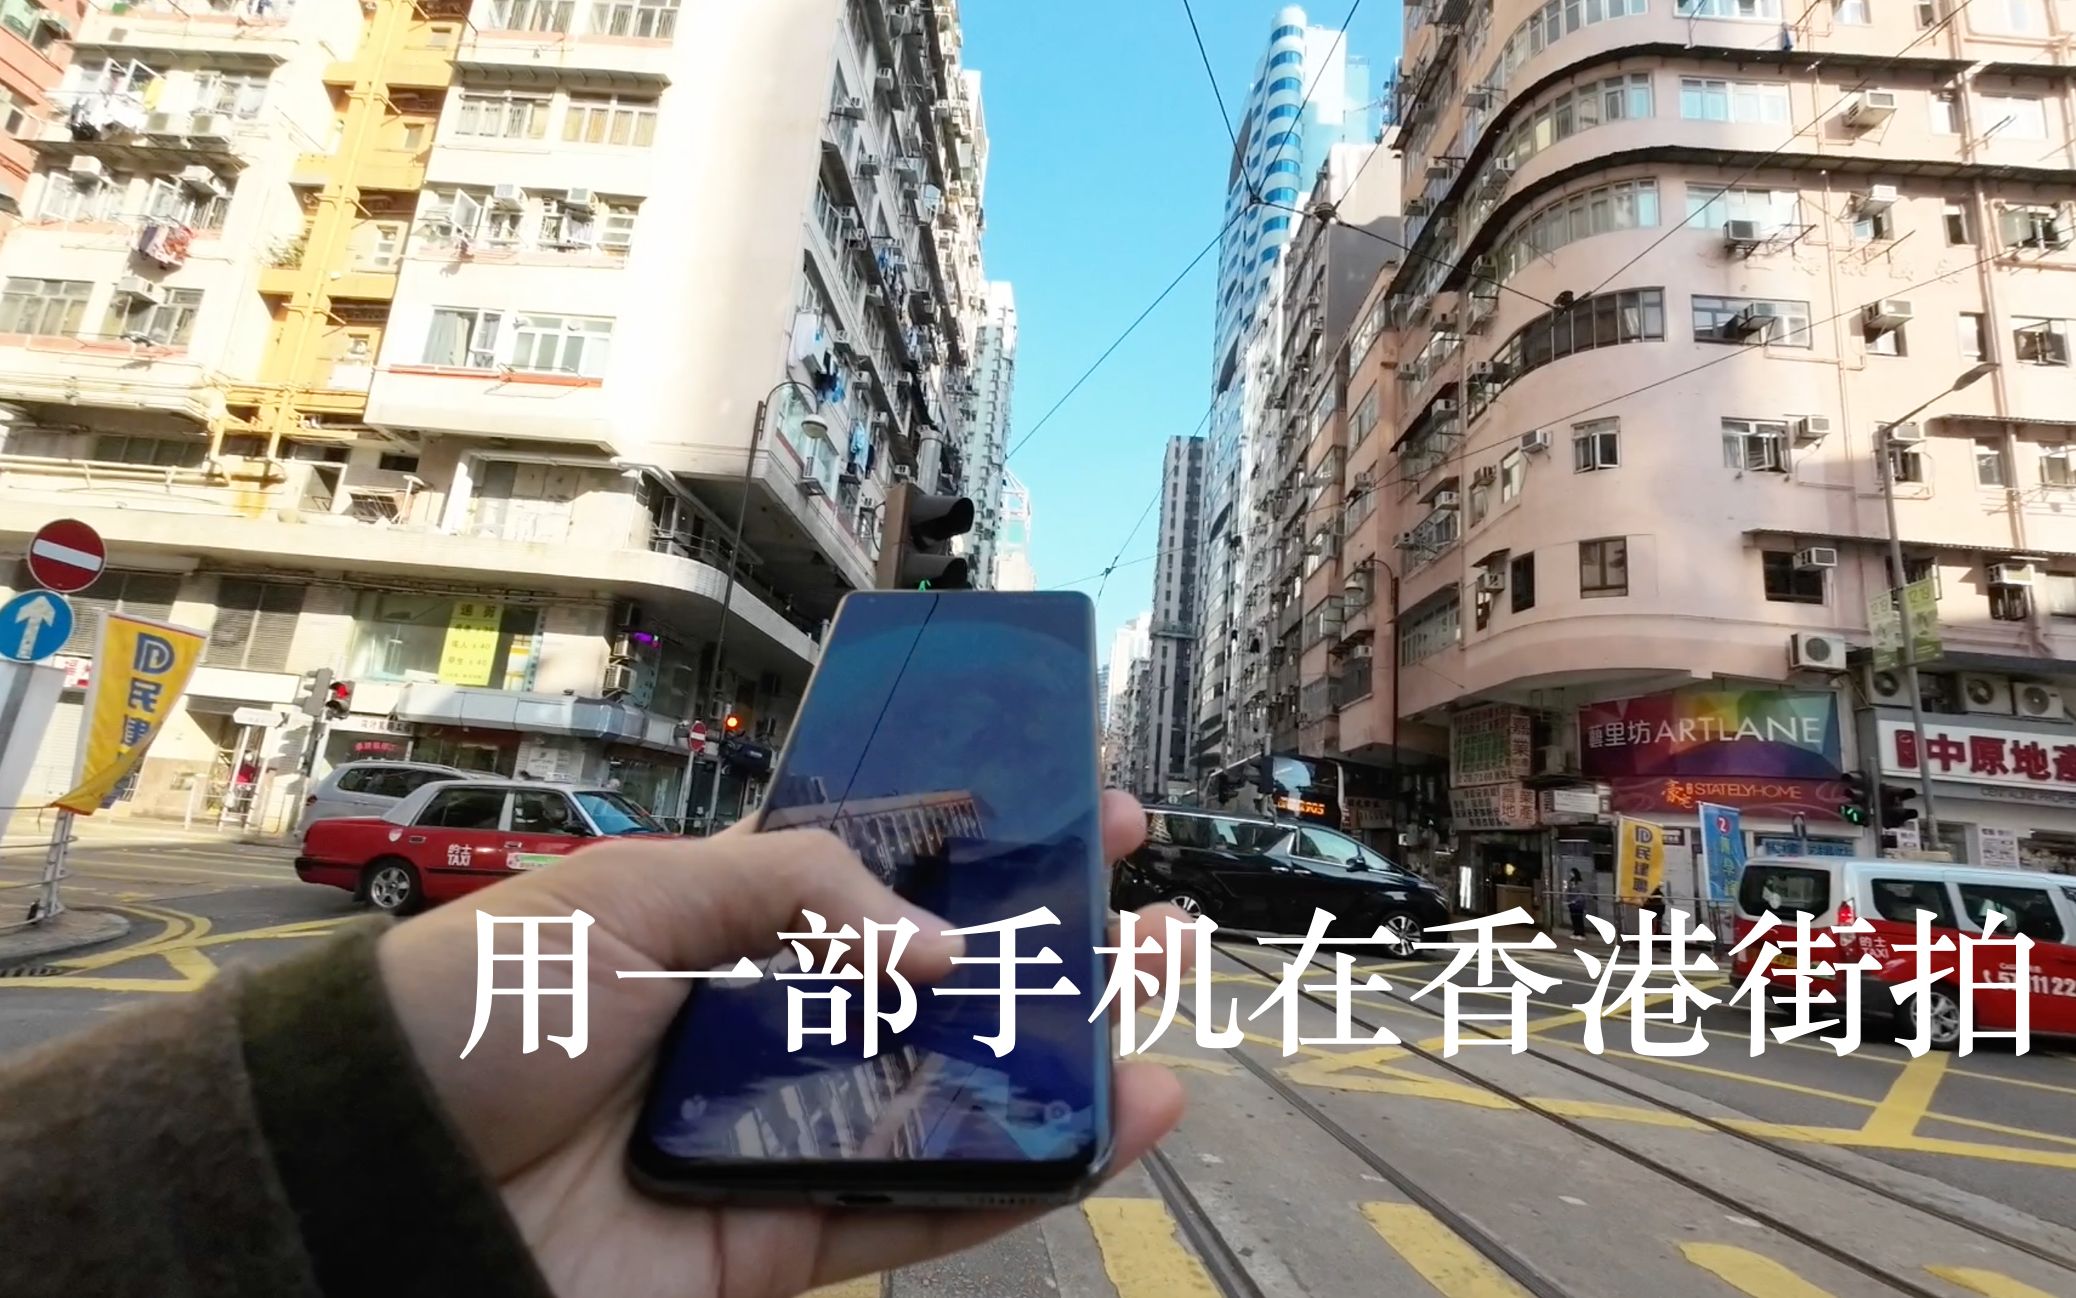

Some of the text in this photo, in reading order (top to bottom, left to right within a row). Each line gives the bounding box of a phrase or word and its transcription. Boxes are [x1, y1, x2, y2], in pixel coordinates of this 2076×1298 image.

[1655, 716, 1821, 743] ARTLANE
[448, 844, 472, 854] 的士
[448, 854, 472, 866] TAXI
[1859, 936, 1887, 948] 的士
[1861, 947, 1889, 959] TAXI
